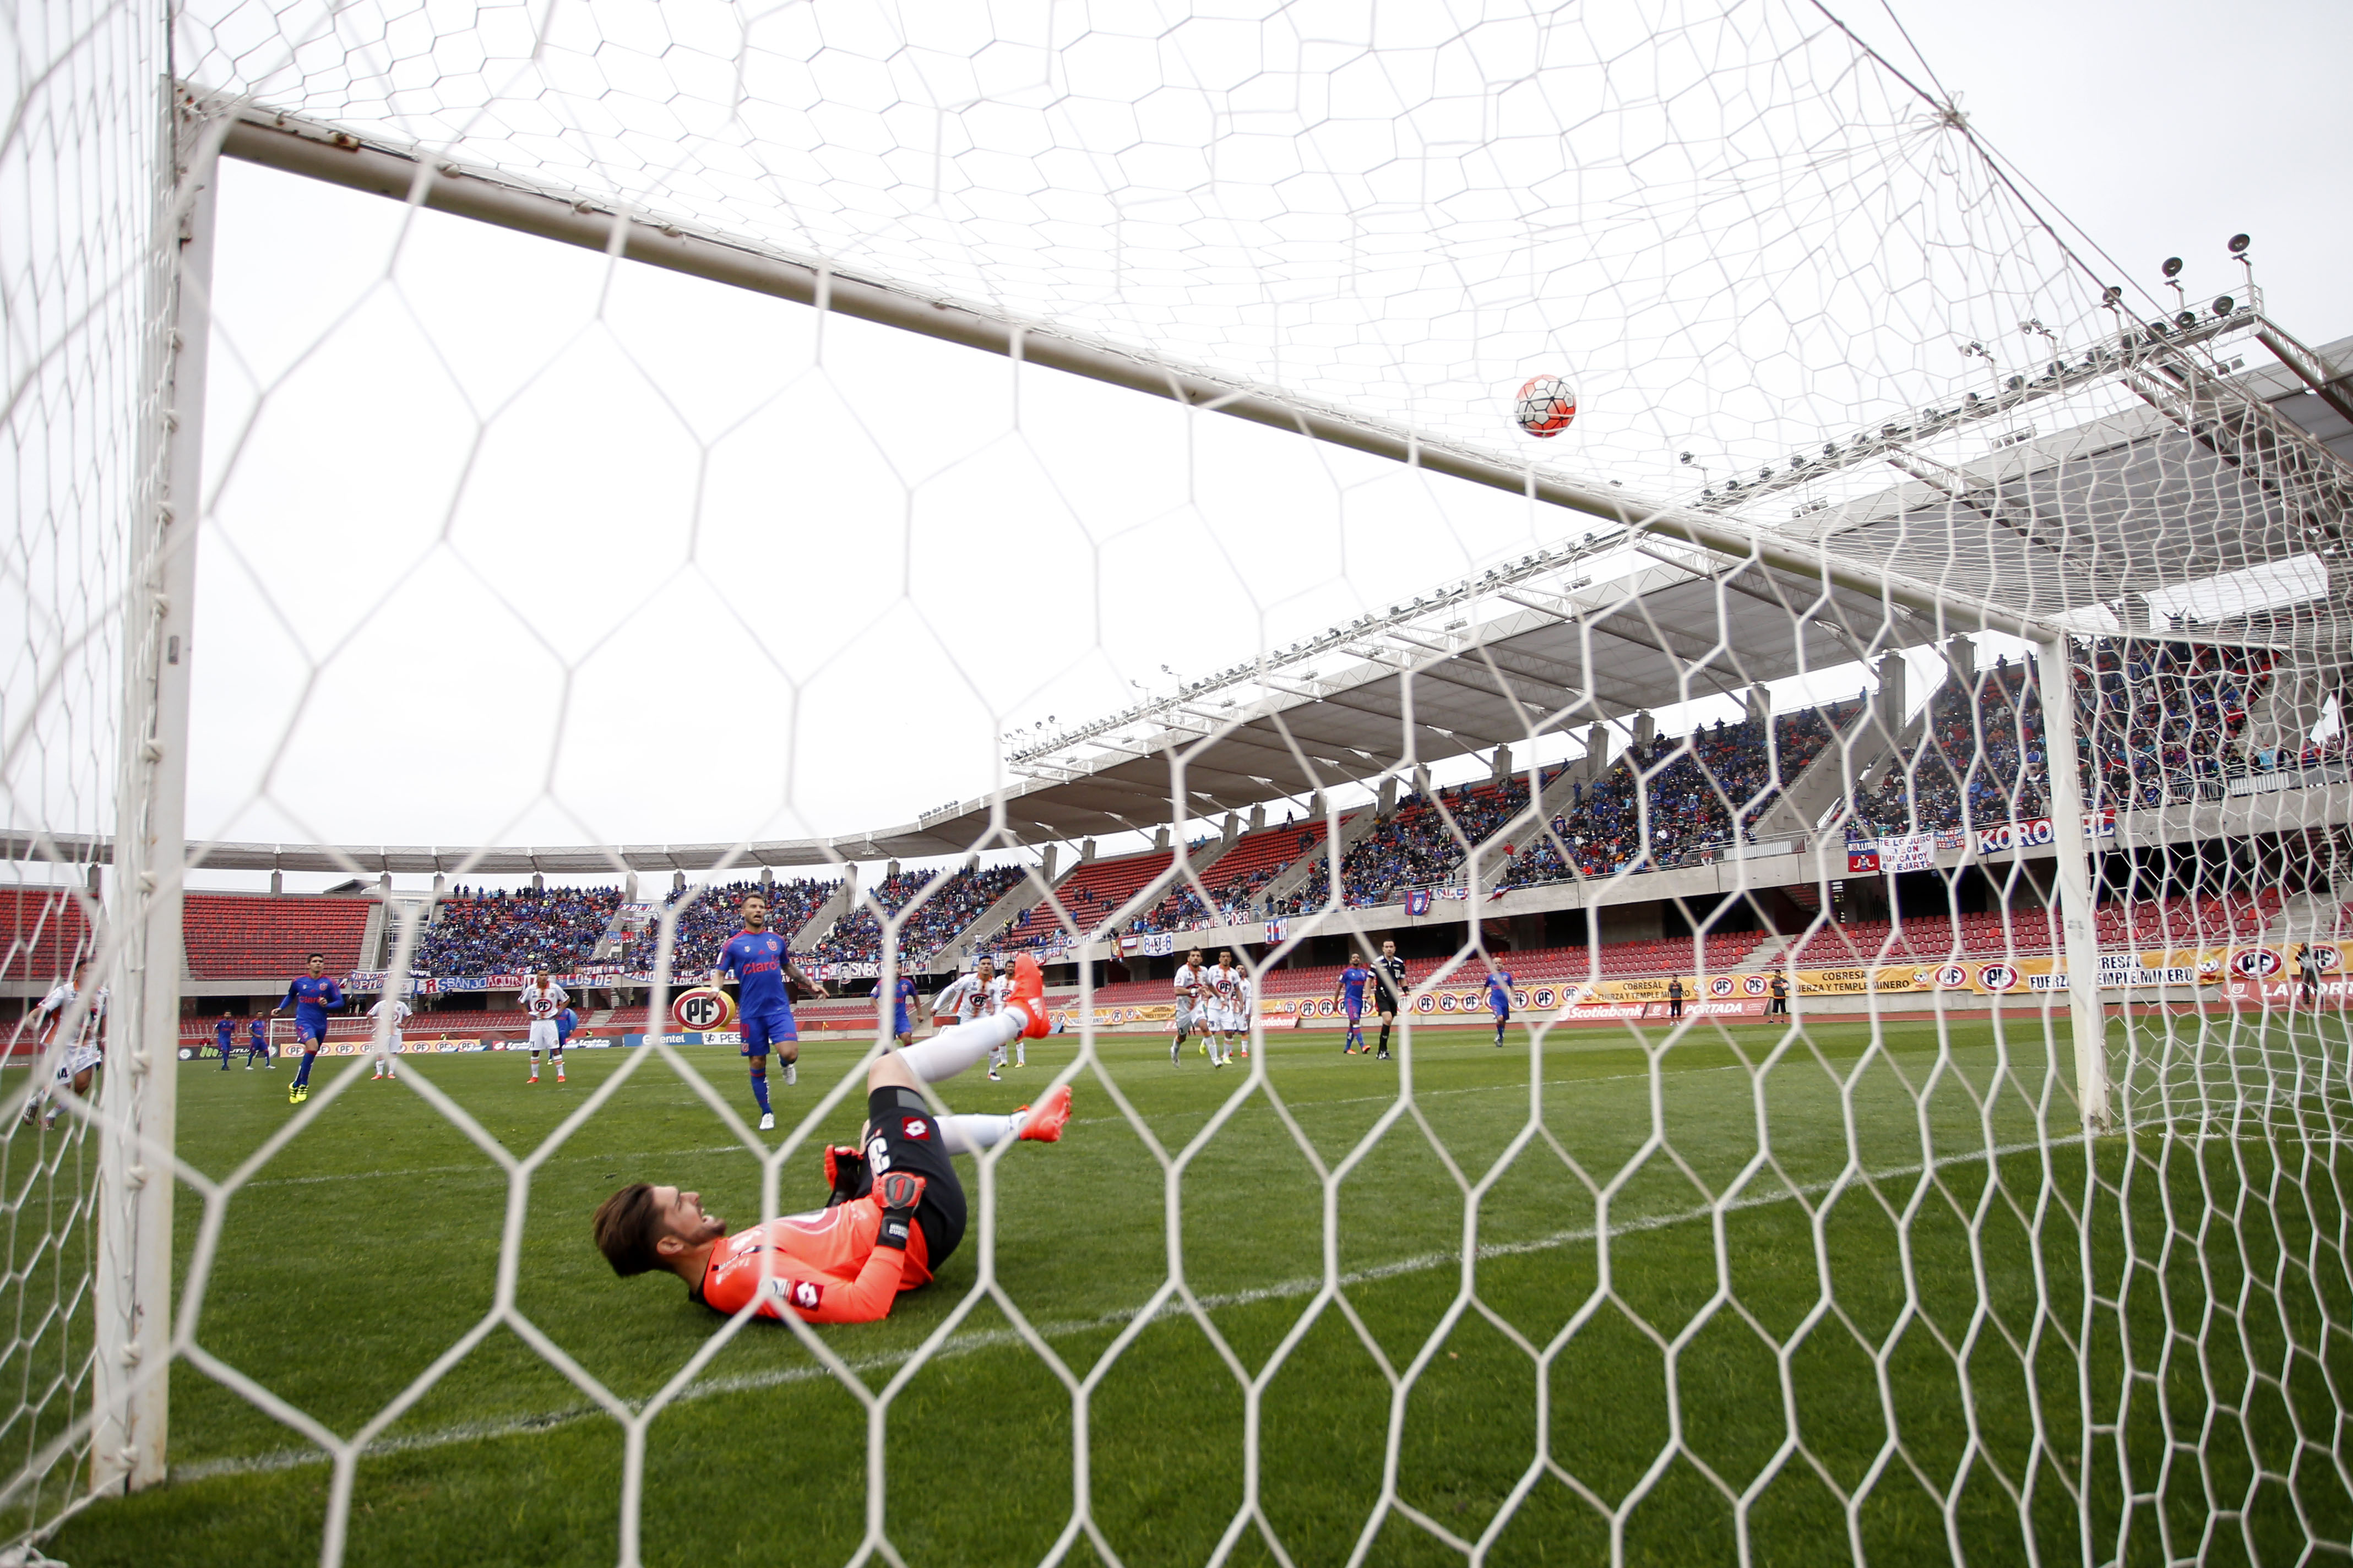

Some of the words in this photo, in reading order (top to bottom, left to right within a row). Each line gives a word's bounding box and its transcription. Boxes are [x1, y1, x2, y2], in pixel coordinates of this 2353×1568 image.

[1893, 838, 1904, 846] LO
[1909, 834, 1931, 845] JURO
[1912, 852, 1928, 861] VOY
[743, 962, 777, 975] Claro
[566, 974, 592, 986] LOS
[595, 974, 612, 987] DE
[1822, 971, 1868, 981] COBRESA
[2031, 974, 2070, 989] FUERZ
[1623, 981, 1663, 990] COBRESAL
[1794, 984, 1824, 992] UERZA
[1632, 992, 1660, 1000] TEMPLE
[1661, 990, 1690, 998] MIRO
[686, 998, 714, 1023] PF
[1569, 1005, 1643, 1019] Scotiabank
[1256, 1016, 1296, 1027] cotiabank
[894, 1178, 906, 1201] 1
